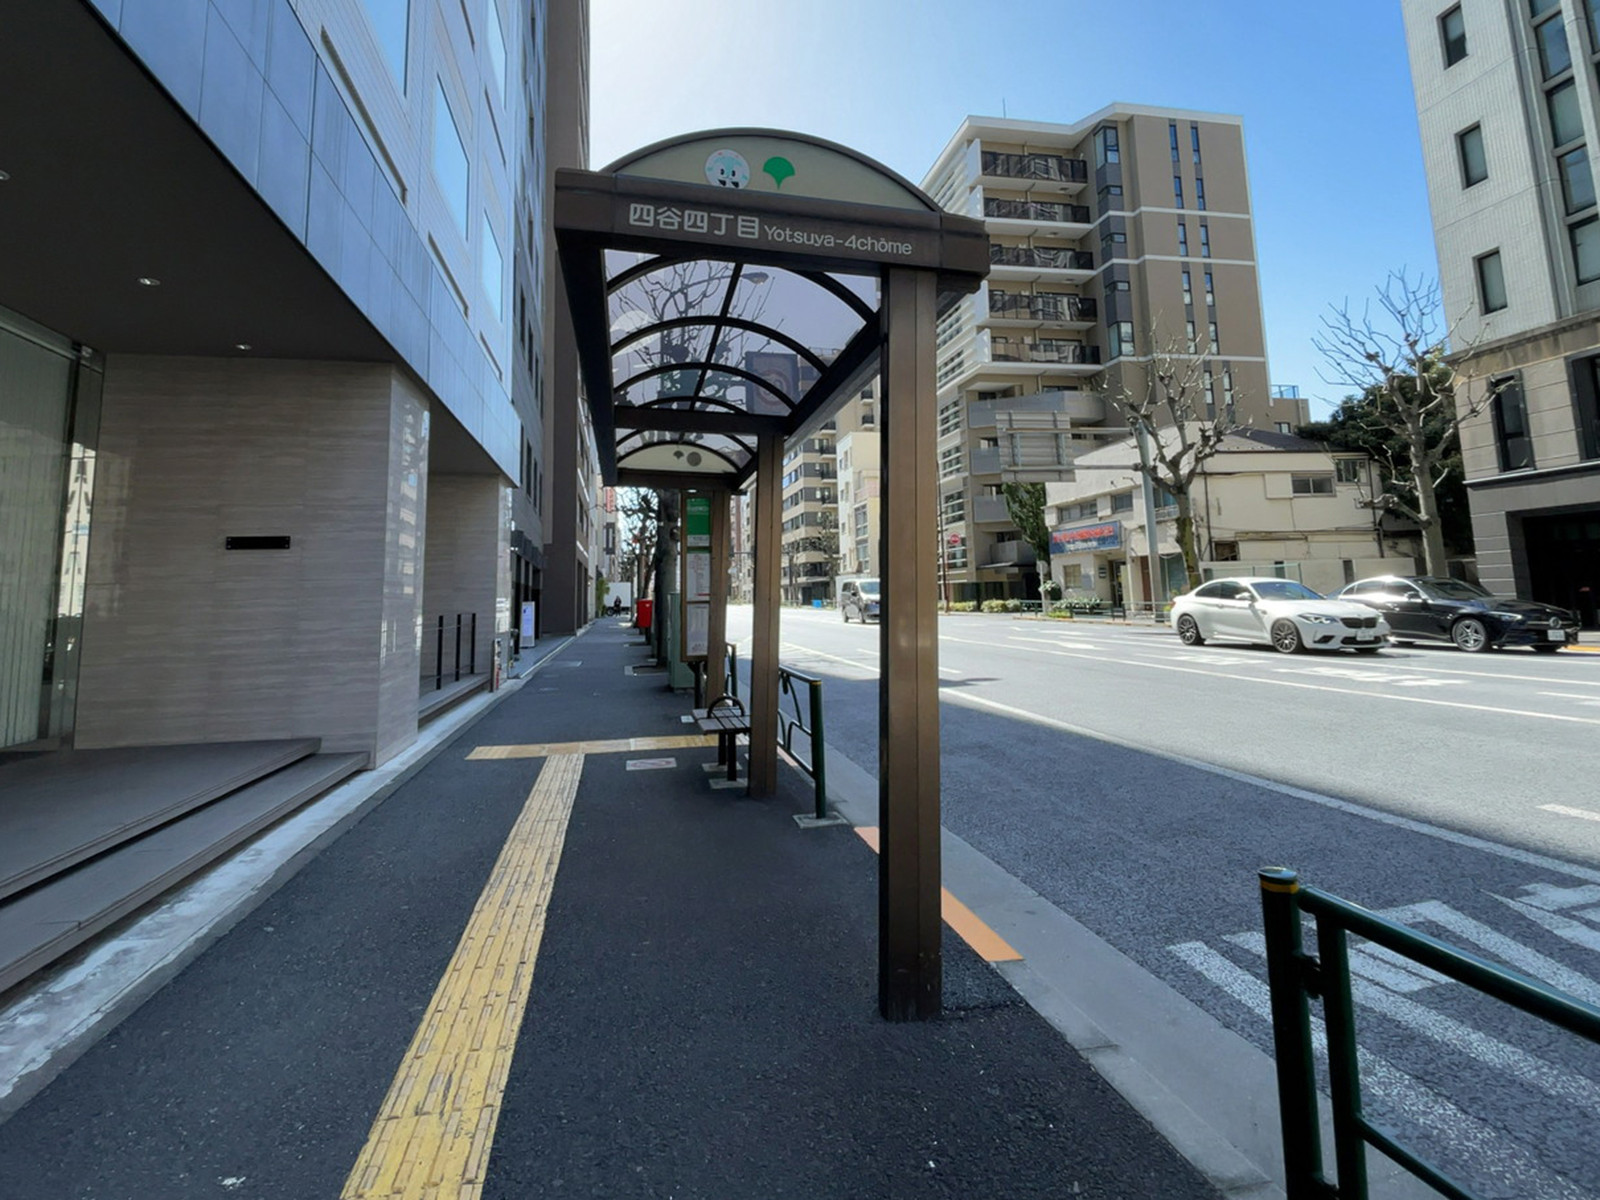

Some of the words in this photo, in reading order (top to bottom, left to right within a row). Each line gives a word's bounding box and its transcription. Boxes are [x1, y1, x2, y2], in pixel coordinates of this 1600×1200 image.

[629, 203, 759, 239] 四谷四丁目
